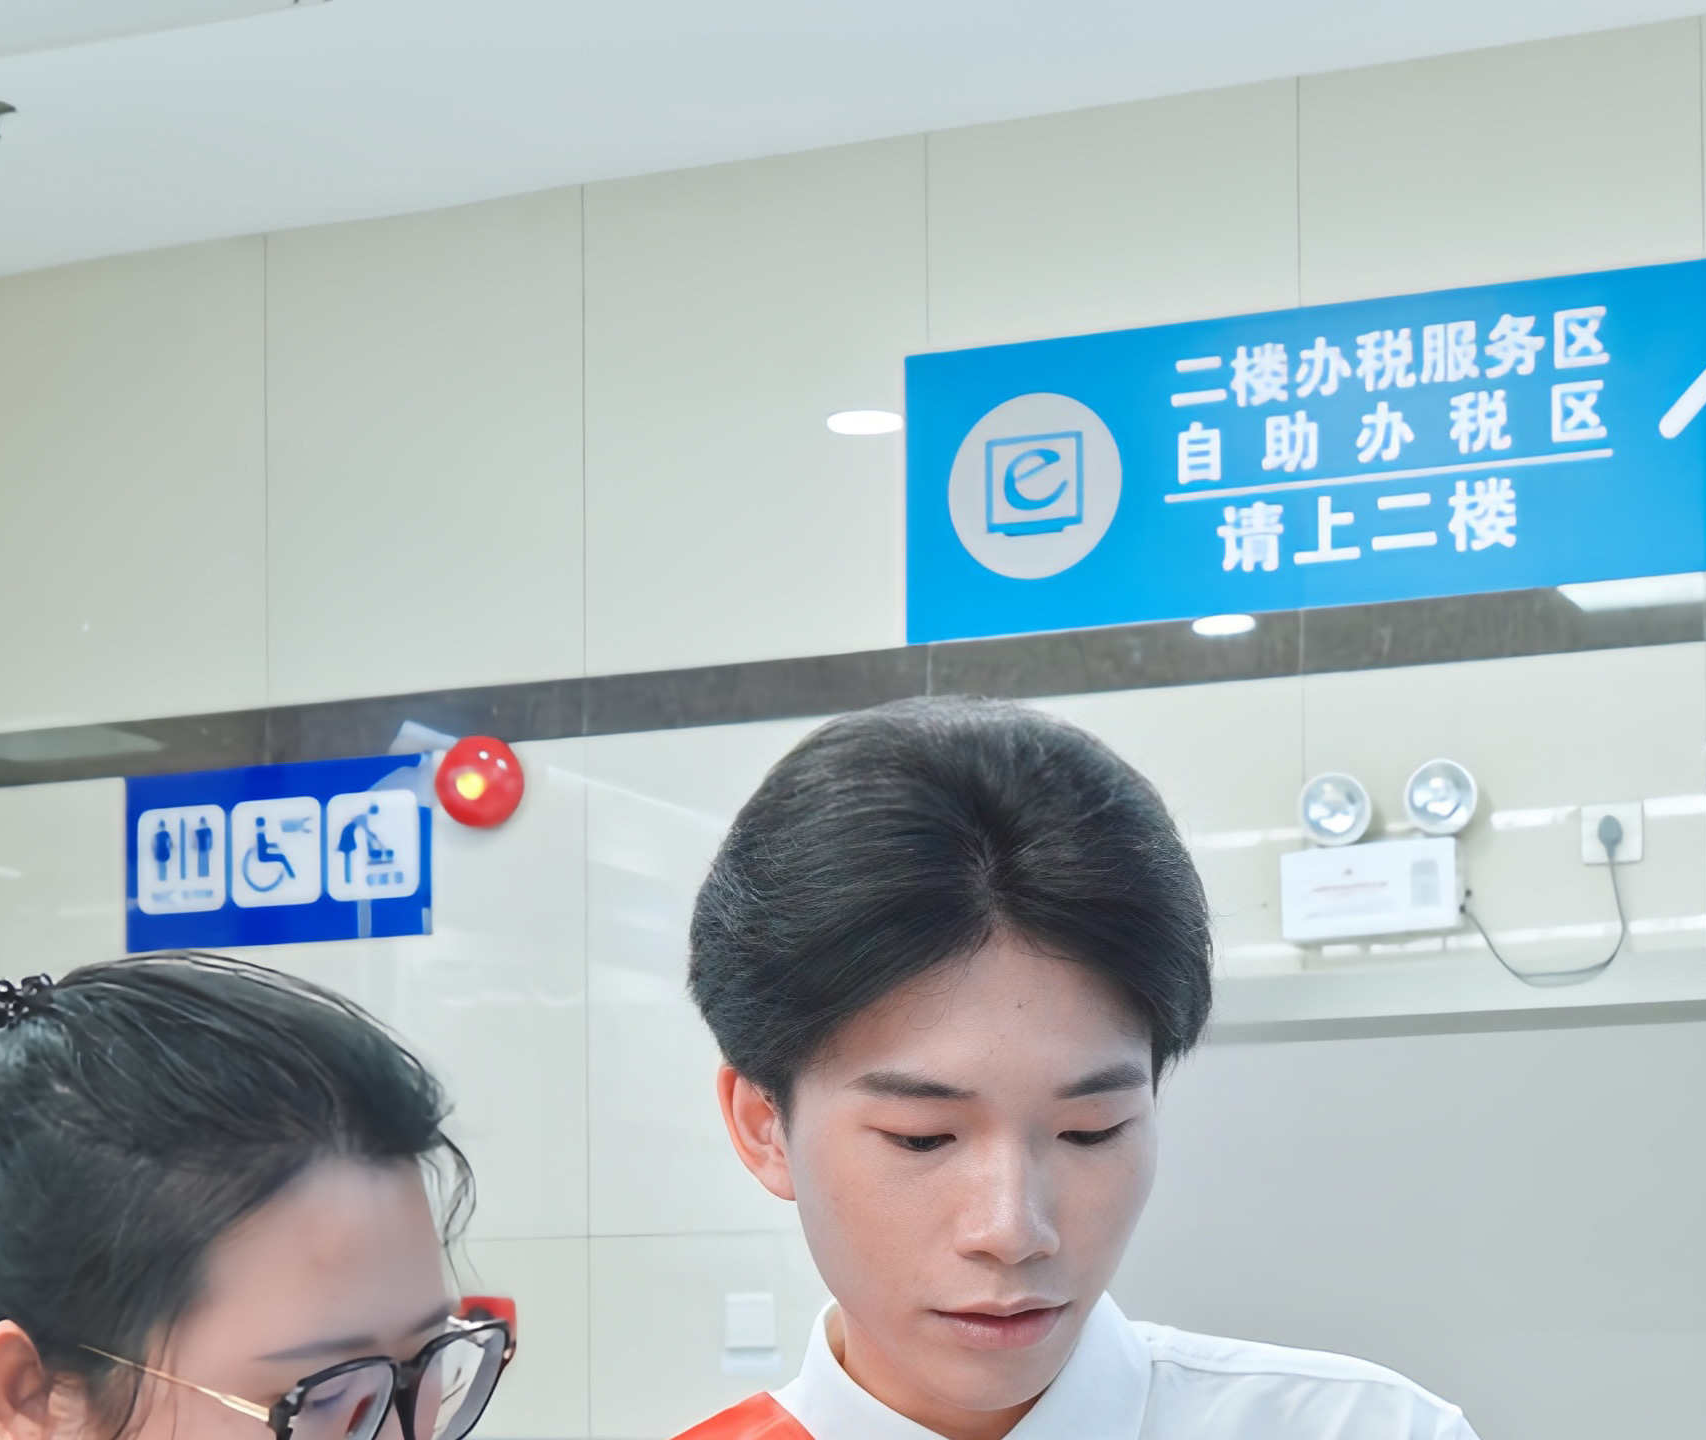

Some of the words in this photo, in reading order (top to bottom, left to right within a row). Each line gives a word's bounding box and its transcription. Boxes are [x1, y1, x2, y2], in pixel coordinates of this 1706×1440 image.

[1171, 305, 1611, 408] 二楼办税服务区
[1177, 379, 1608, 485] 自助办税区
[1217, 477, 1518, 573] 请上二楼
